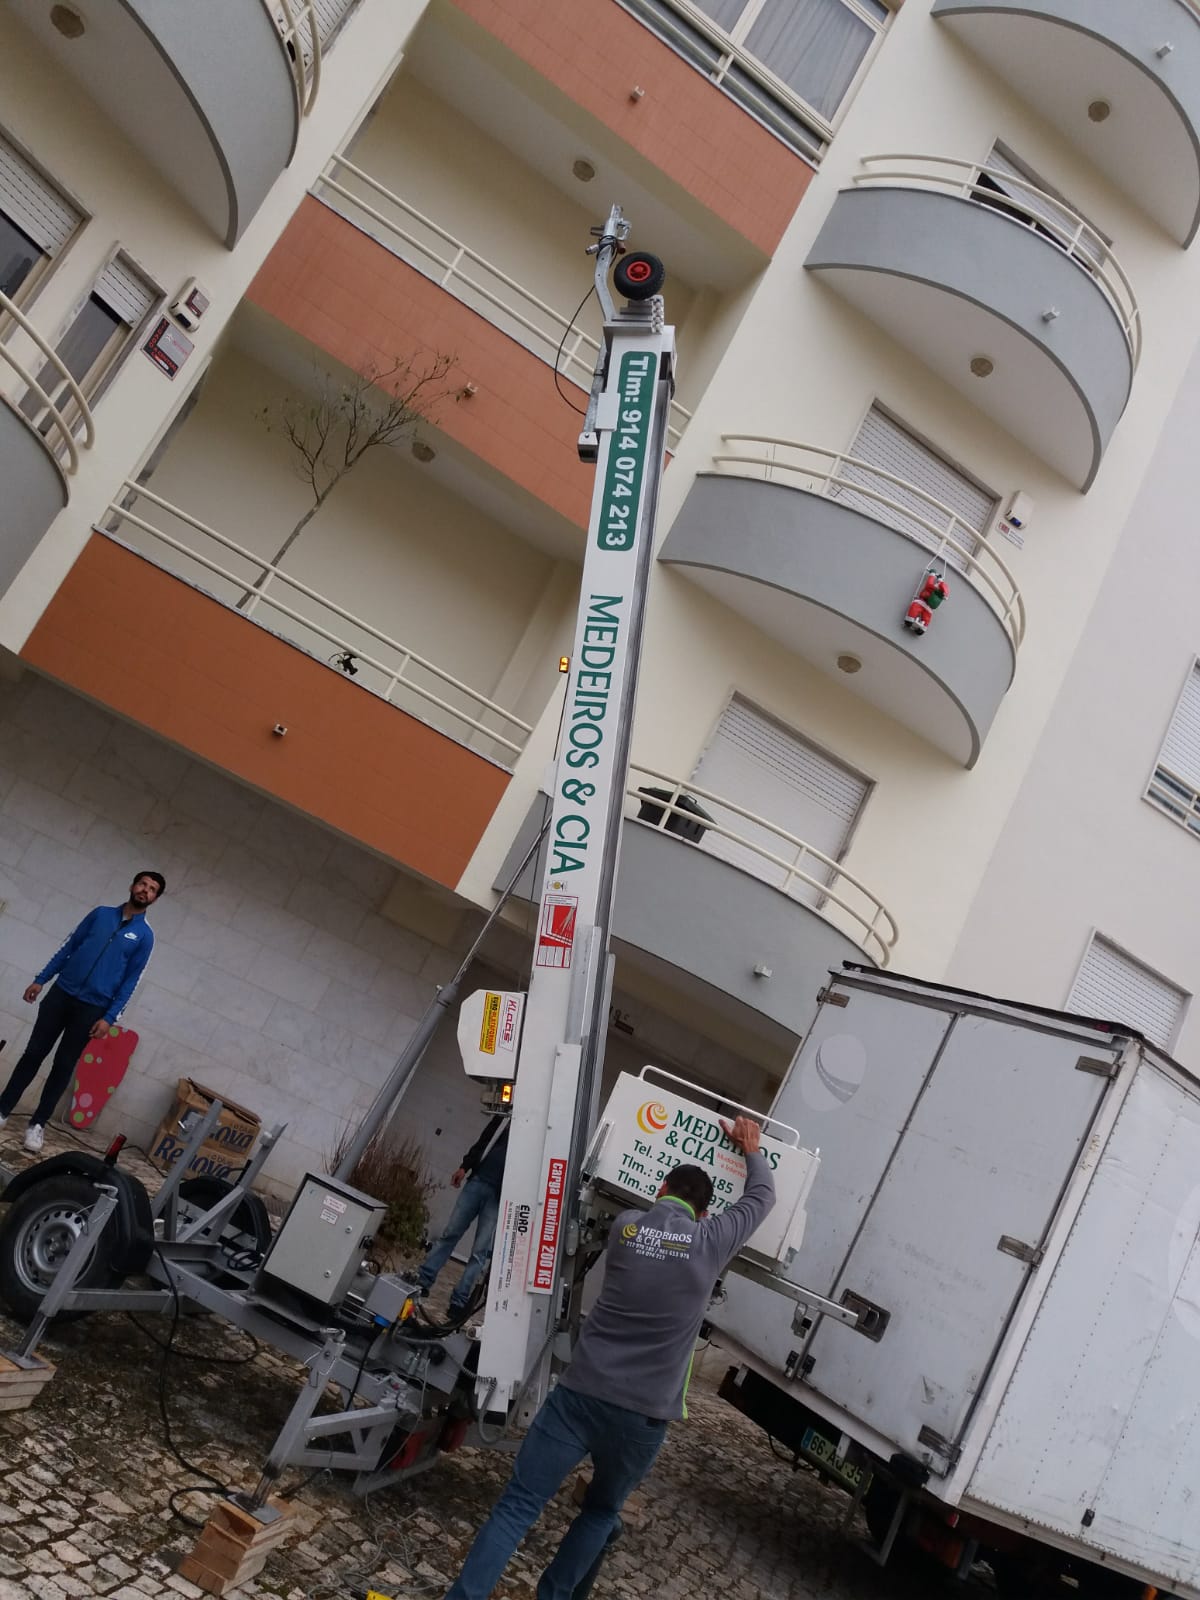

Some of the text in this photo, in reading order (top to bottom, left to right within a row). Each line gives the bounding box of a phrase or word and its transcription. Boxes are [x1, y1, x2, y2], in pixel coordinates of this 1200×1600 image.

[605, 356, 649, 546] Tlm: 914 074 213
[565, 594, 624, 769] MEDEIROS
[561, 778, 596, 806] &
[550, 814, 590, 875] CIA
[622, 1153, 653, 1176] Tlm.:
[665, 1130, 716, 1166] & CIA
[617, 1170, 659, 1198] Tlm.:9
[633, 1139, 734, 1194] Tel. 212 185
[537, 1162, 563, 1286] carga maxima 200 KG
[635, 1235, 643, 1243] &
[644, 1237, 661, 1247] CIA
[639, 1225, 693, 1244] MEDEIROS
